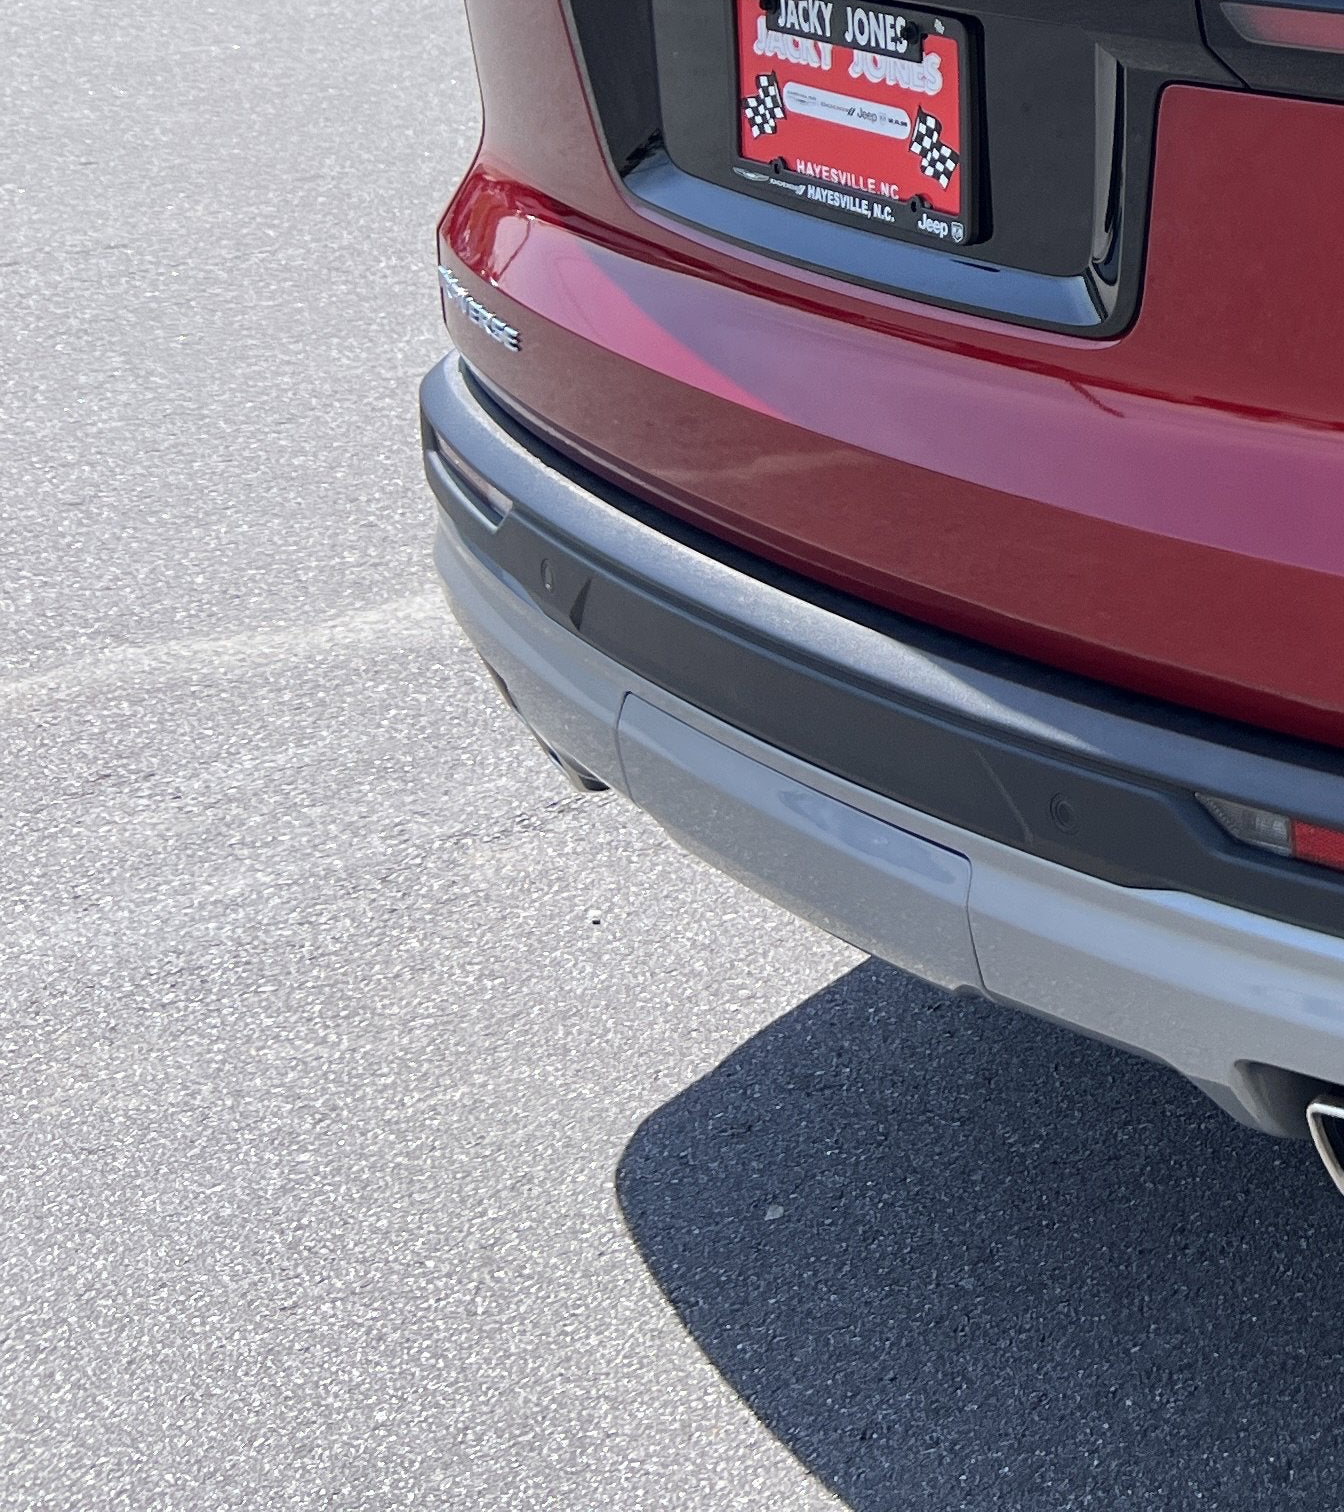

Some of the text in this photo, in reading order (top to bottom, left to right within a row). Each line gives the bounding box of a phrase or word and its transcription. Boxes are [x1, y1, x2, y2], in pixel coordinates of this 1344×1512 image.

[845, 6, 908, 53] JONES
[807, 184, 871, 219] HAYESVILLE,
[917, 213, 949, 238] Jeep
